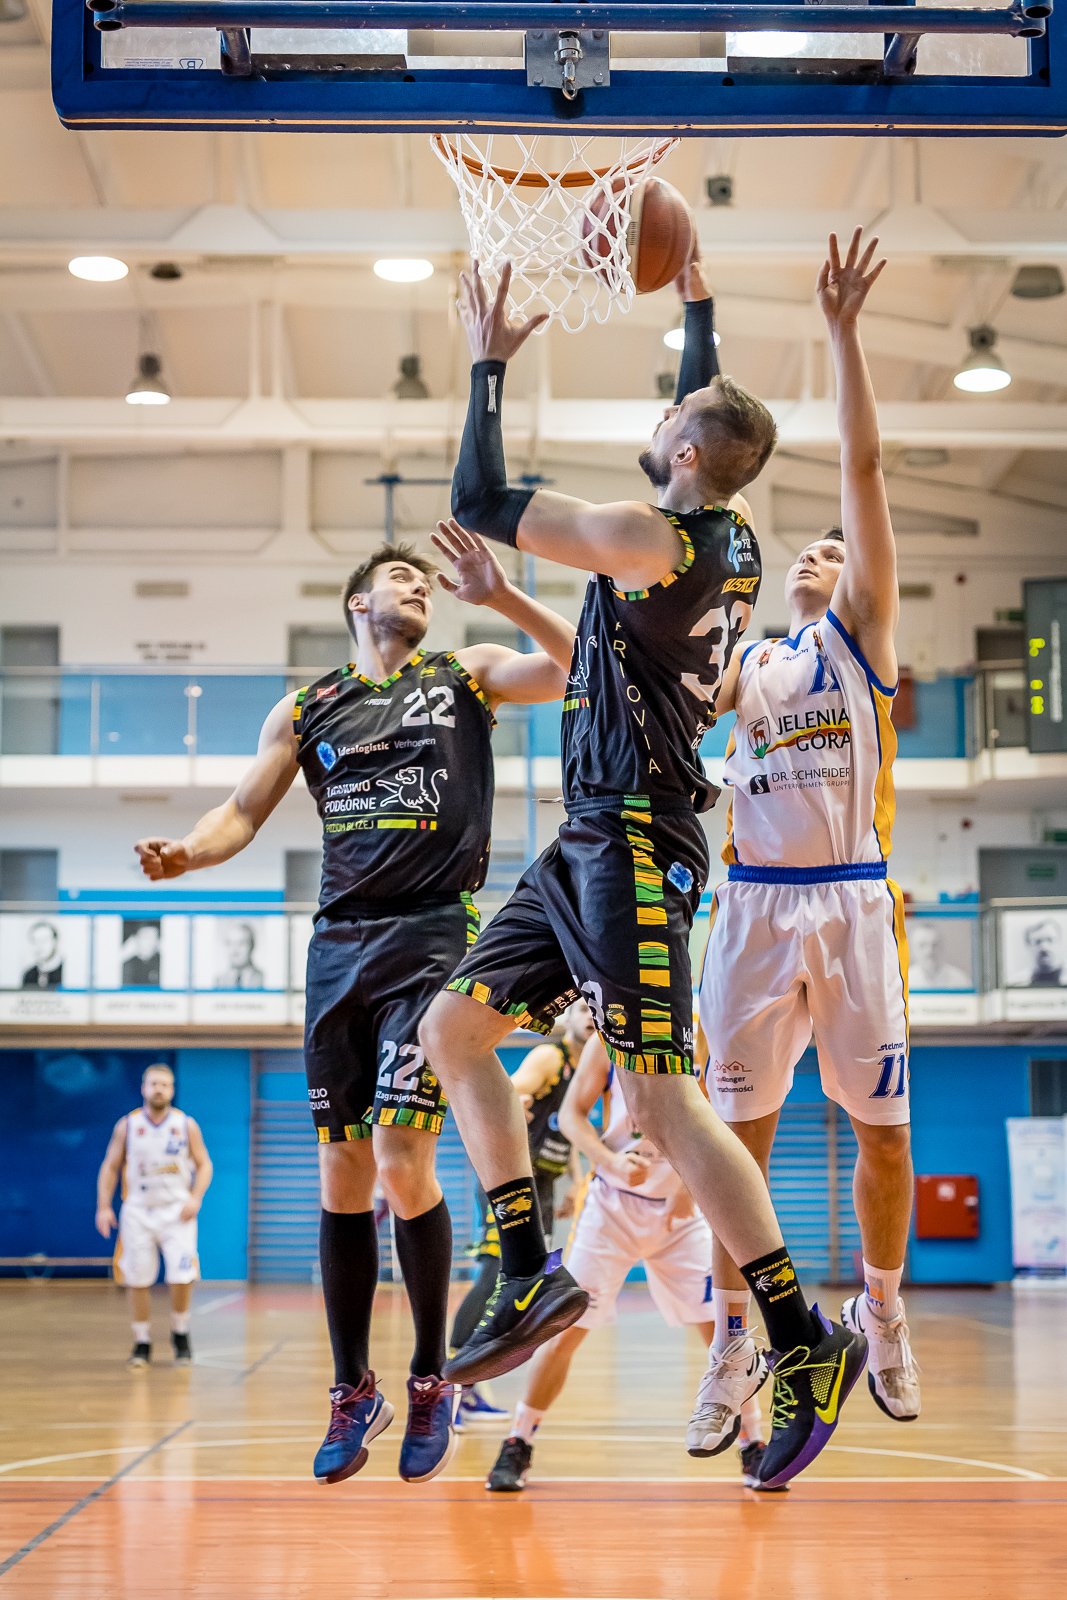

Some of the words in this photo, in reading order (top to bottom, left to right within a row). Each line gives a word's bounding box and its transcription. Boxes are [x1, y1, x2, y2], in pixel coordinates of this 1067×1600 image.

[402, 685, 456, 728] 22
[775, 707, 851, 736] JELENIA
[796, 730, 852, 752] GÓRA
[772, 771, 790, 783] DR.
[324, 795, 377, 813] PODGÓRNE
[377, 1040, 425, 1092] 22
[868, 1053, 906, 1099] 11
